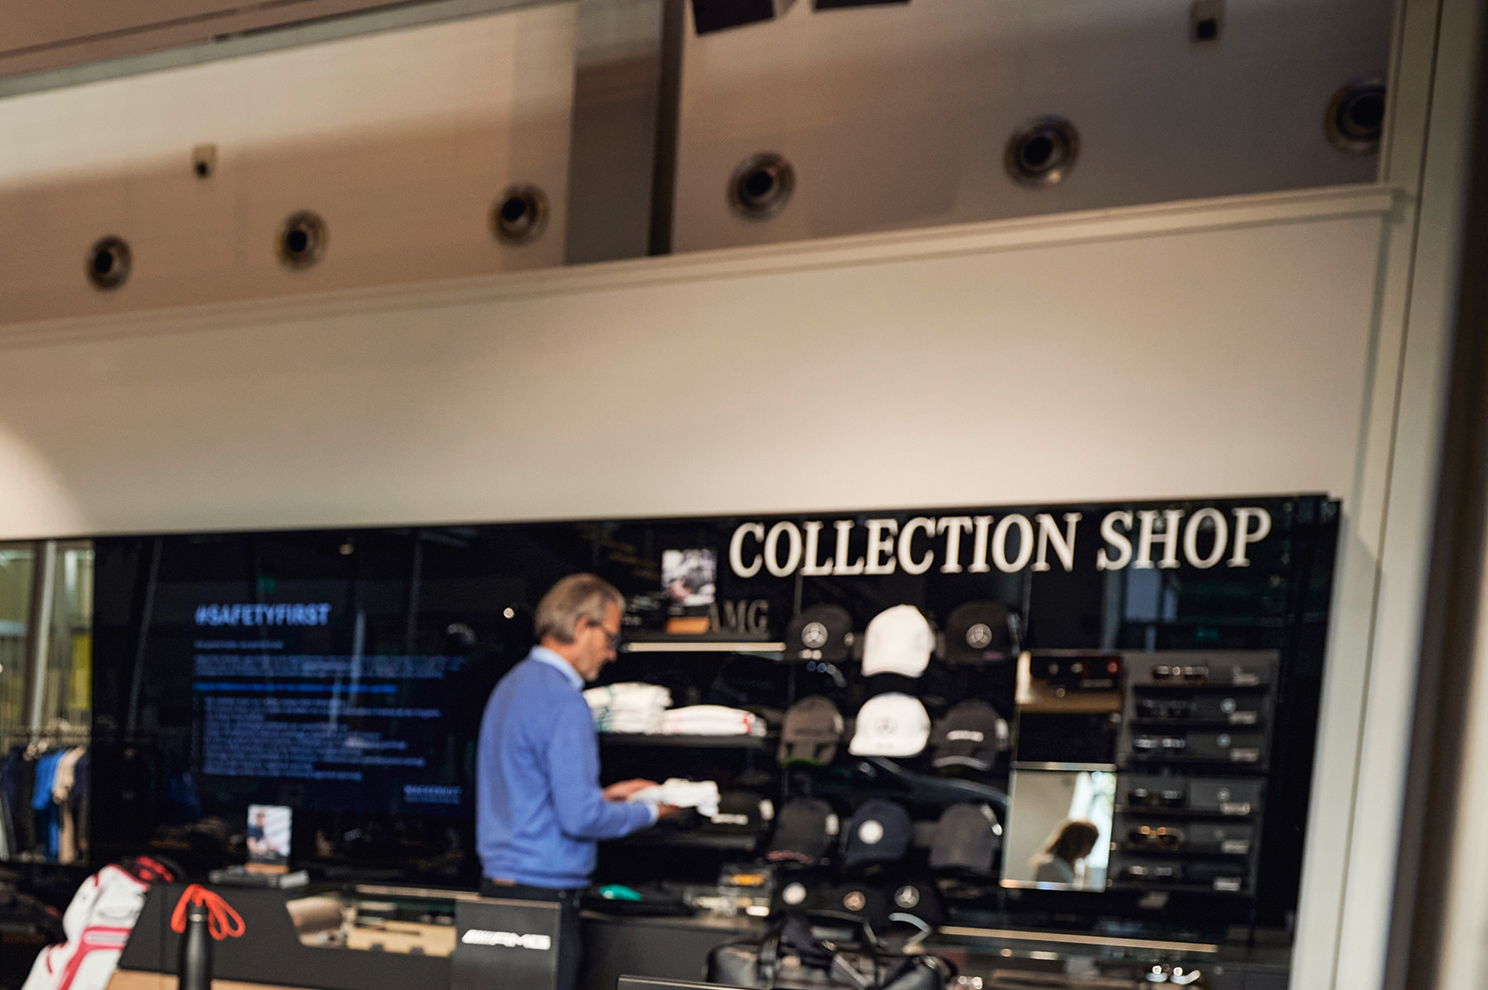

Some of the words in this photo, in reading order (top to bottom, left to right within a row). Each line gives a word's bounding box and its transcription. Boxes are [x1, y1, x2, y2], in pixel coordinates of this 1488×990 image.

[728, 511, 1083, 578] COLLECTION
[1096, 506, 1273, 571] SHOP
[194, 602, 332, 627] #SAFETYFIRST
